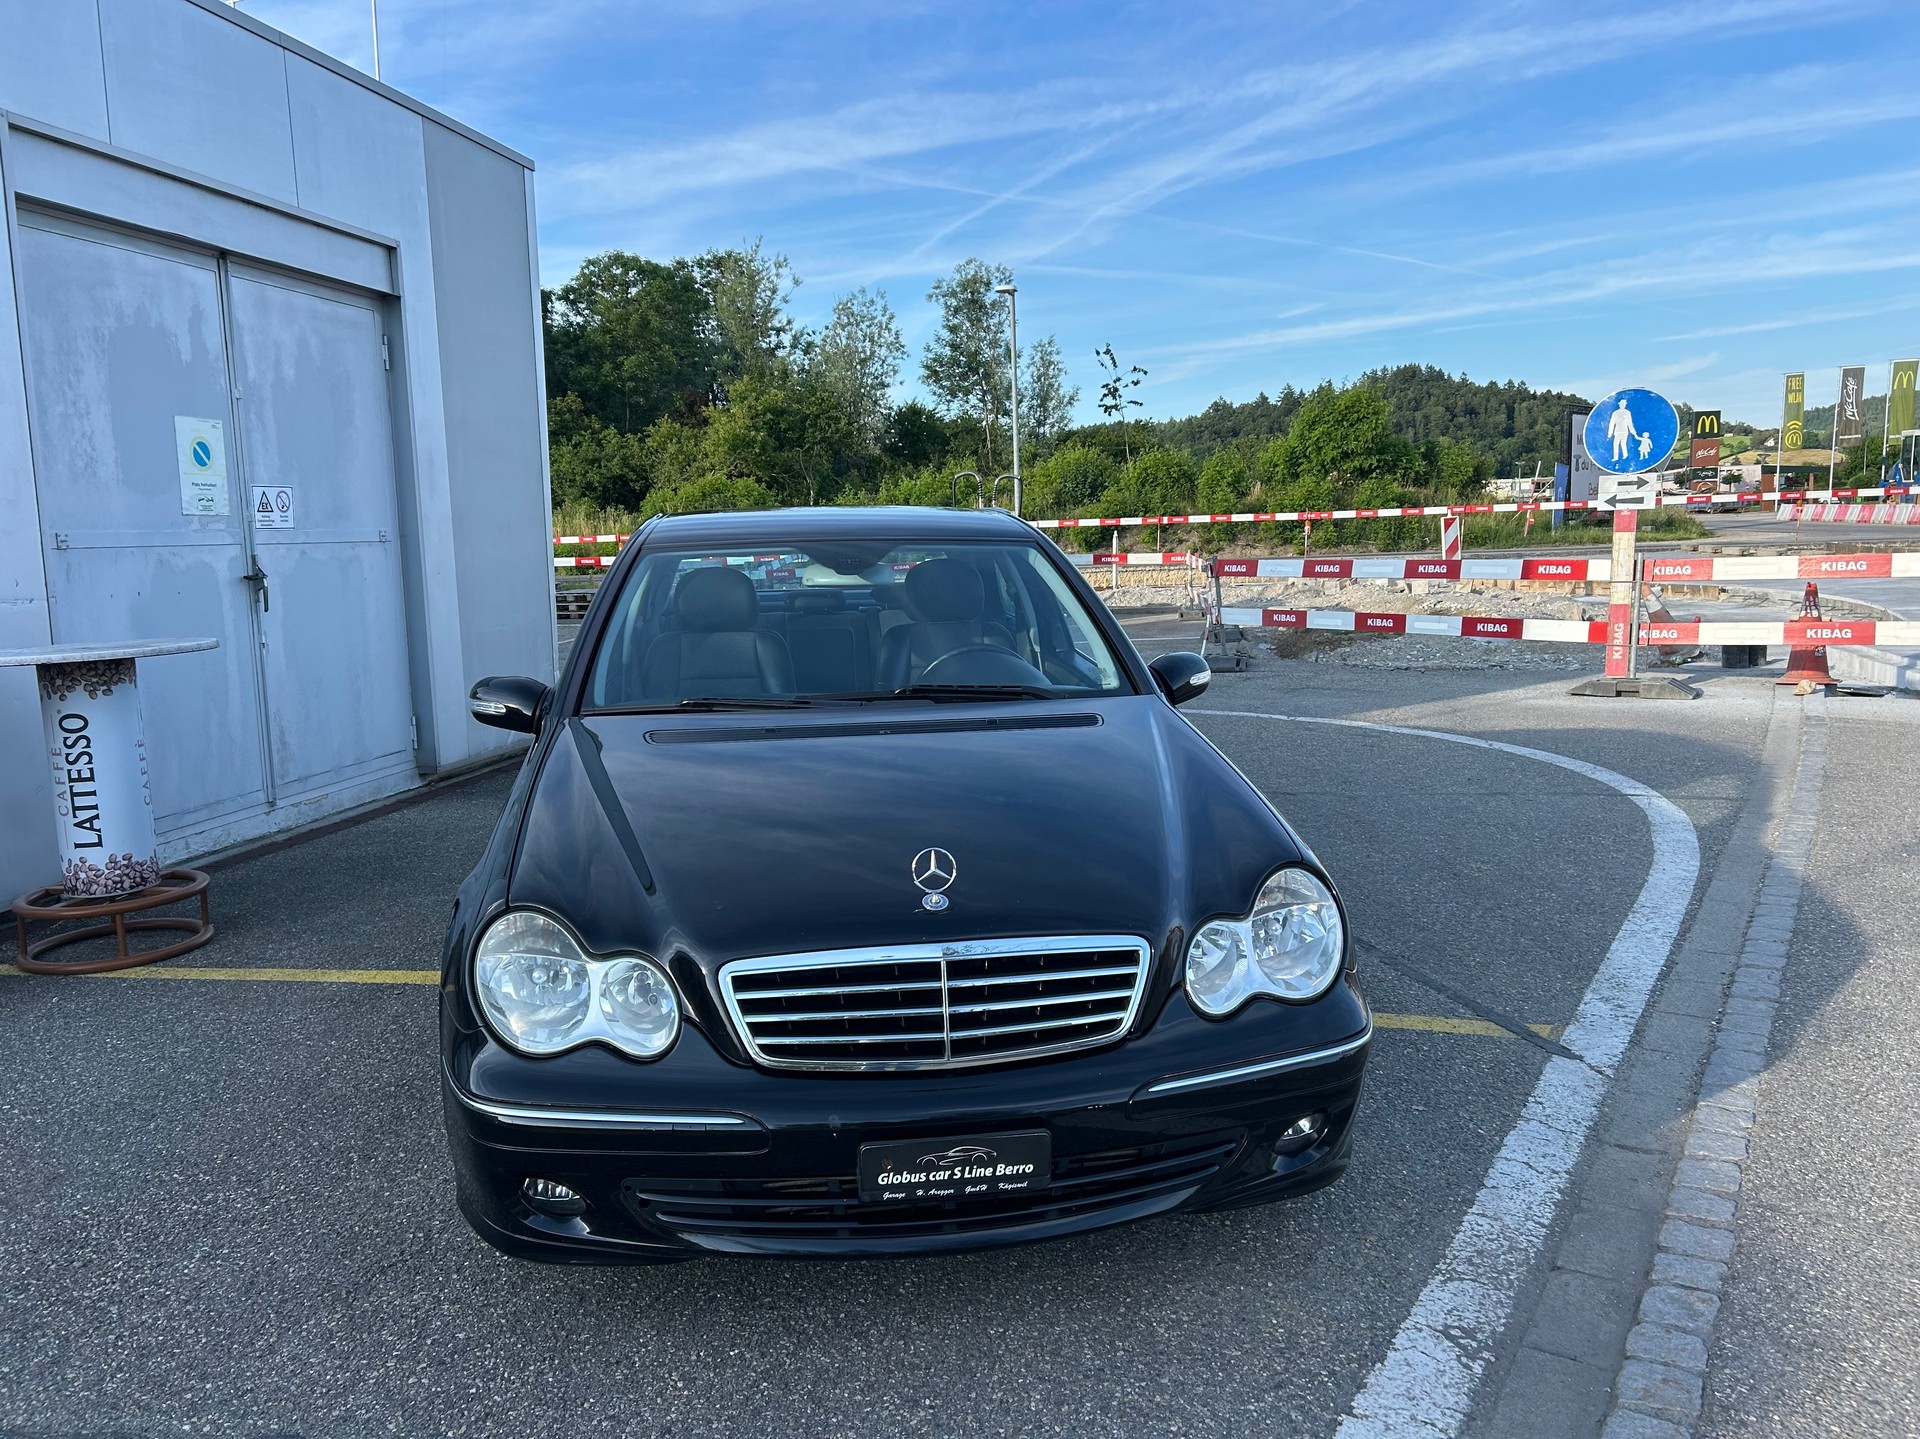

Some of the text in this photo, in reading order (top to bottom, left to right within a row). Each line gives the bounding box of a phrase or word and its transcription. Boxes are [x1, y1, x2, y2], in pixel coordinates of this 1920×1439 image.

[1224, 564, 1571, 575] KIBAG KIBAG KIBAG KIBAG
[1653, 561, 1867, 576] KIBAG KIBAG
[1273, 613, 1508, 633] KIBAG KIBAG KIBAG
[1612, 622, 1625, 660] KIBAG
[1639, 628, 1852, 639] KIBAG KIBAG
[58, 713, 103, 850] LATTESSO
[877, 1163, 1034, 1185] Globus car S Line Berro
[882, 1191, 906, 1200] Garage
[965, 1184, 988, 1194] GmbH
